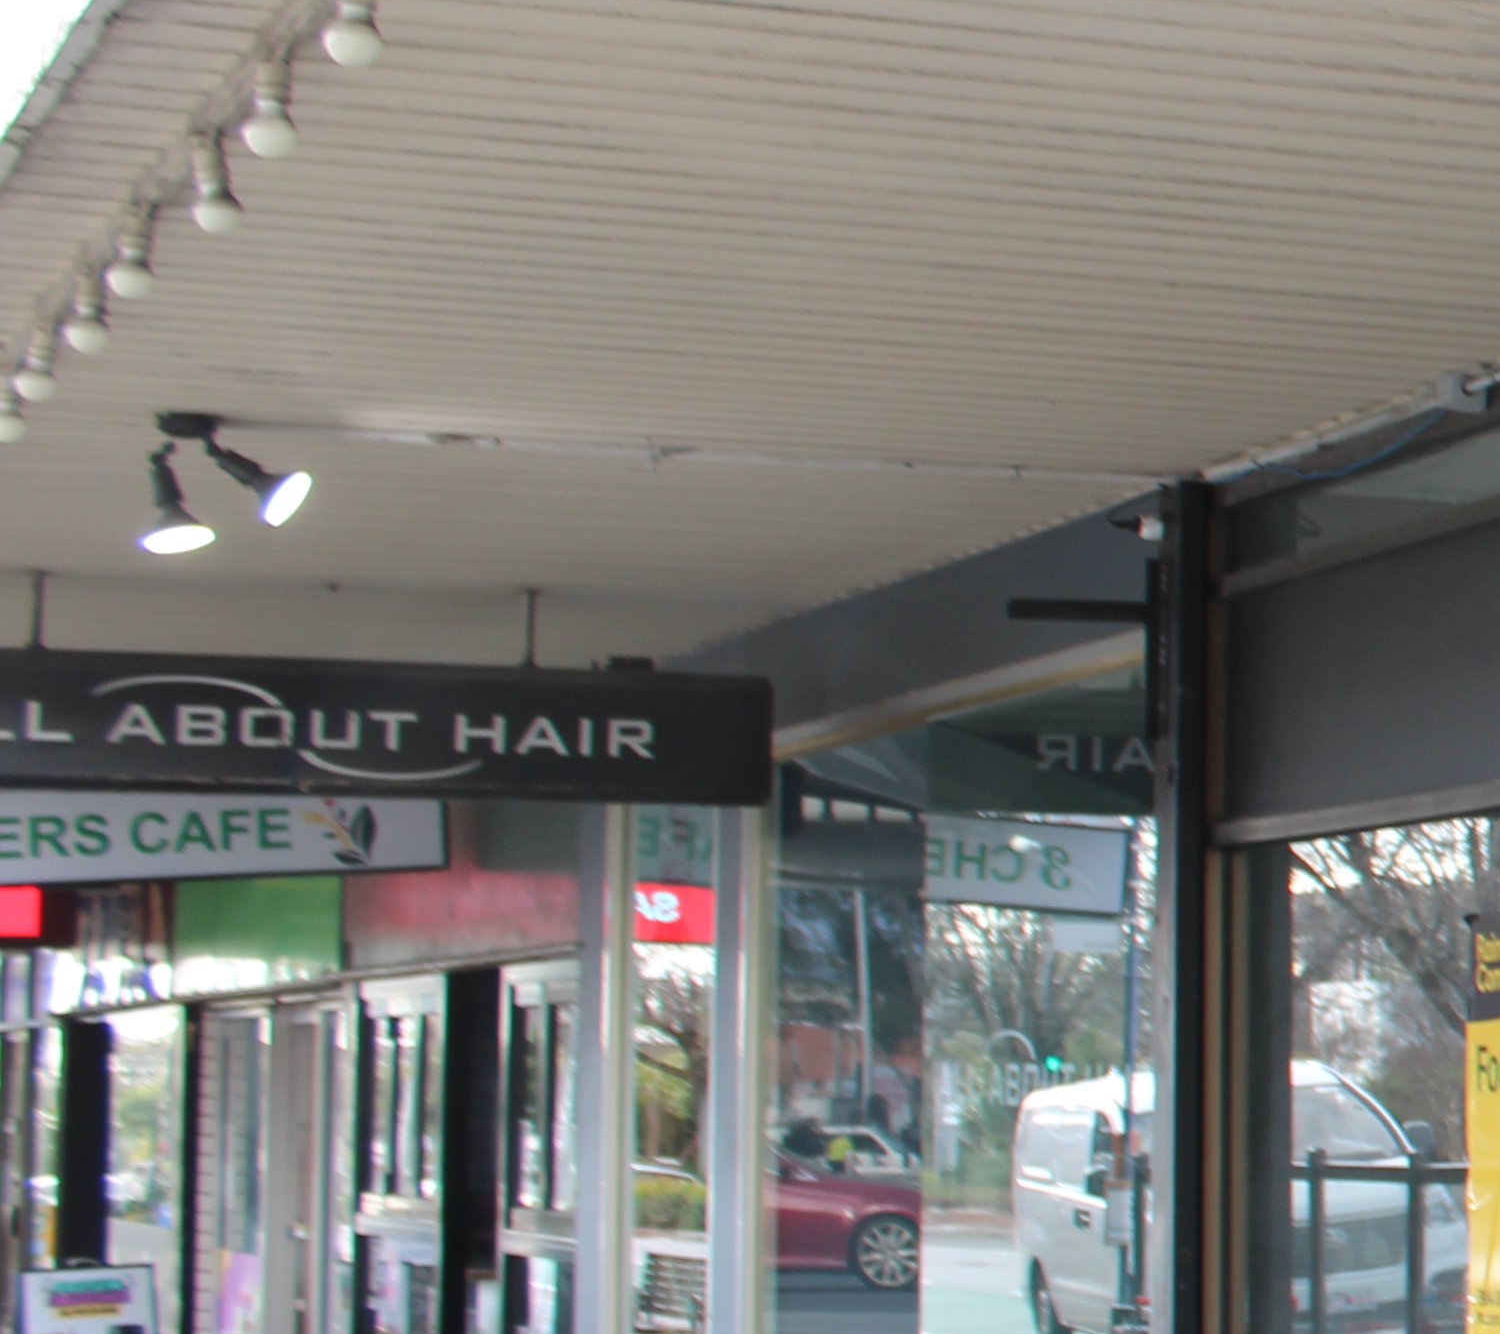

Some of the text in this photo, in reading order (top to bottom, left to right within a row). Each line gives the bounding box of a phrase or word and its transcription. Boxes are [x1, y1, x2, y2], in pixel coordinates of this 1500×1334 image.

[105, 702, 420, 751] ABOUT
[453, 713, 656, 760] HAIR
[129, 806, 292, 855] CAFE
